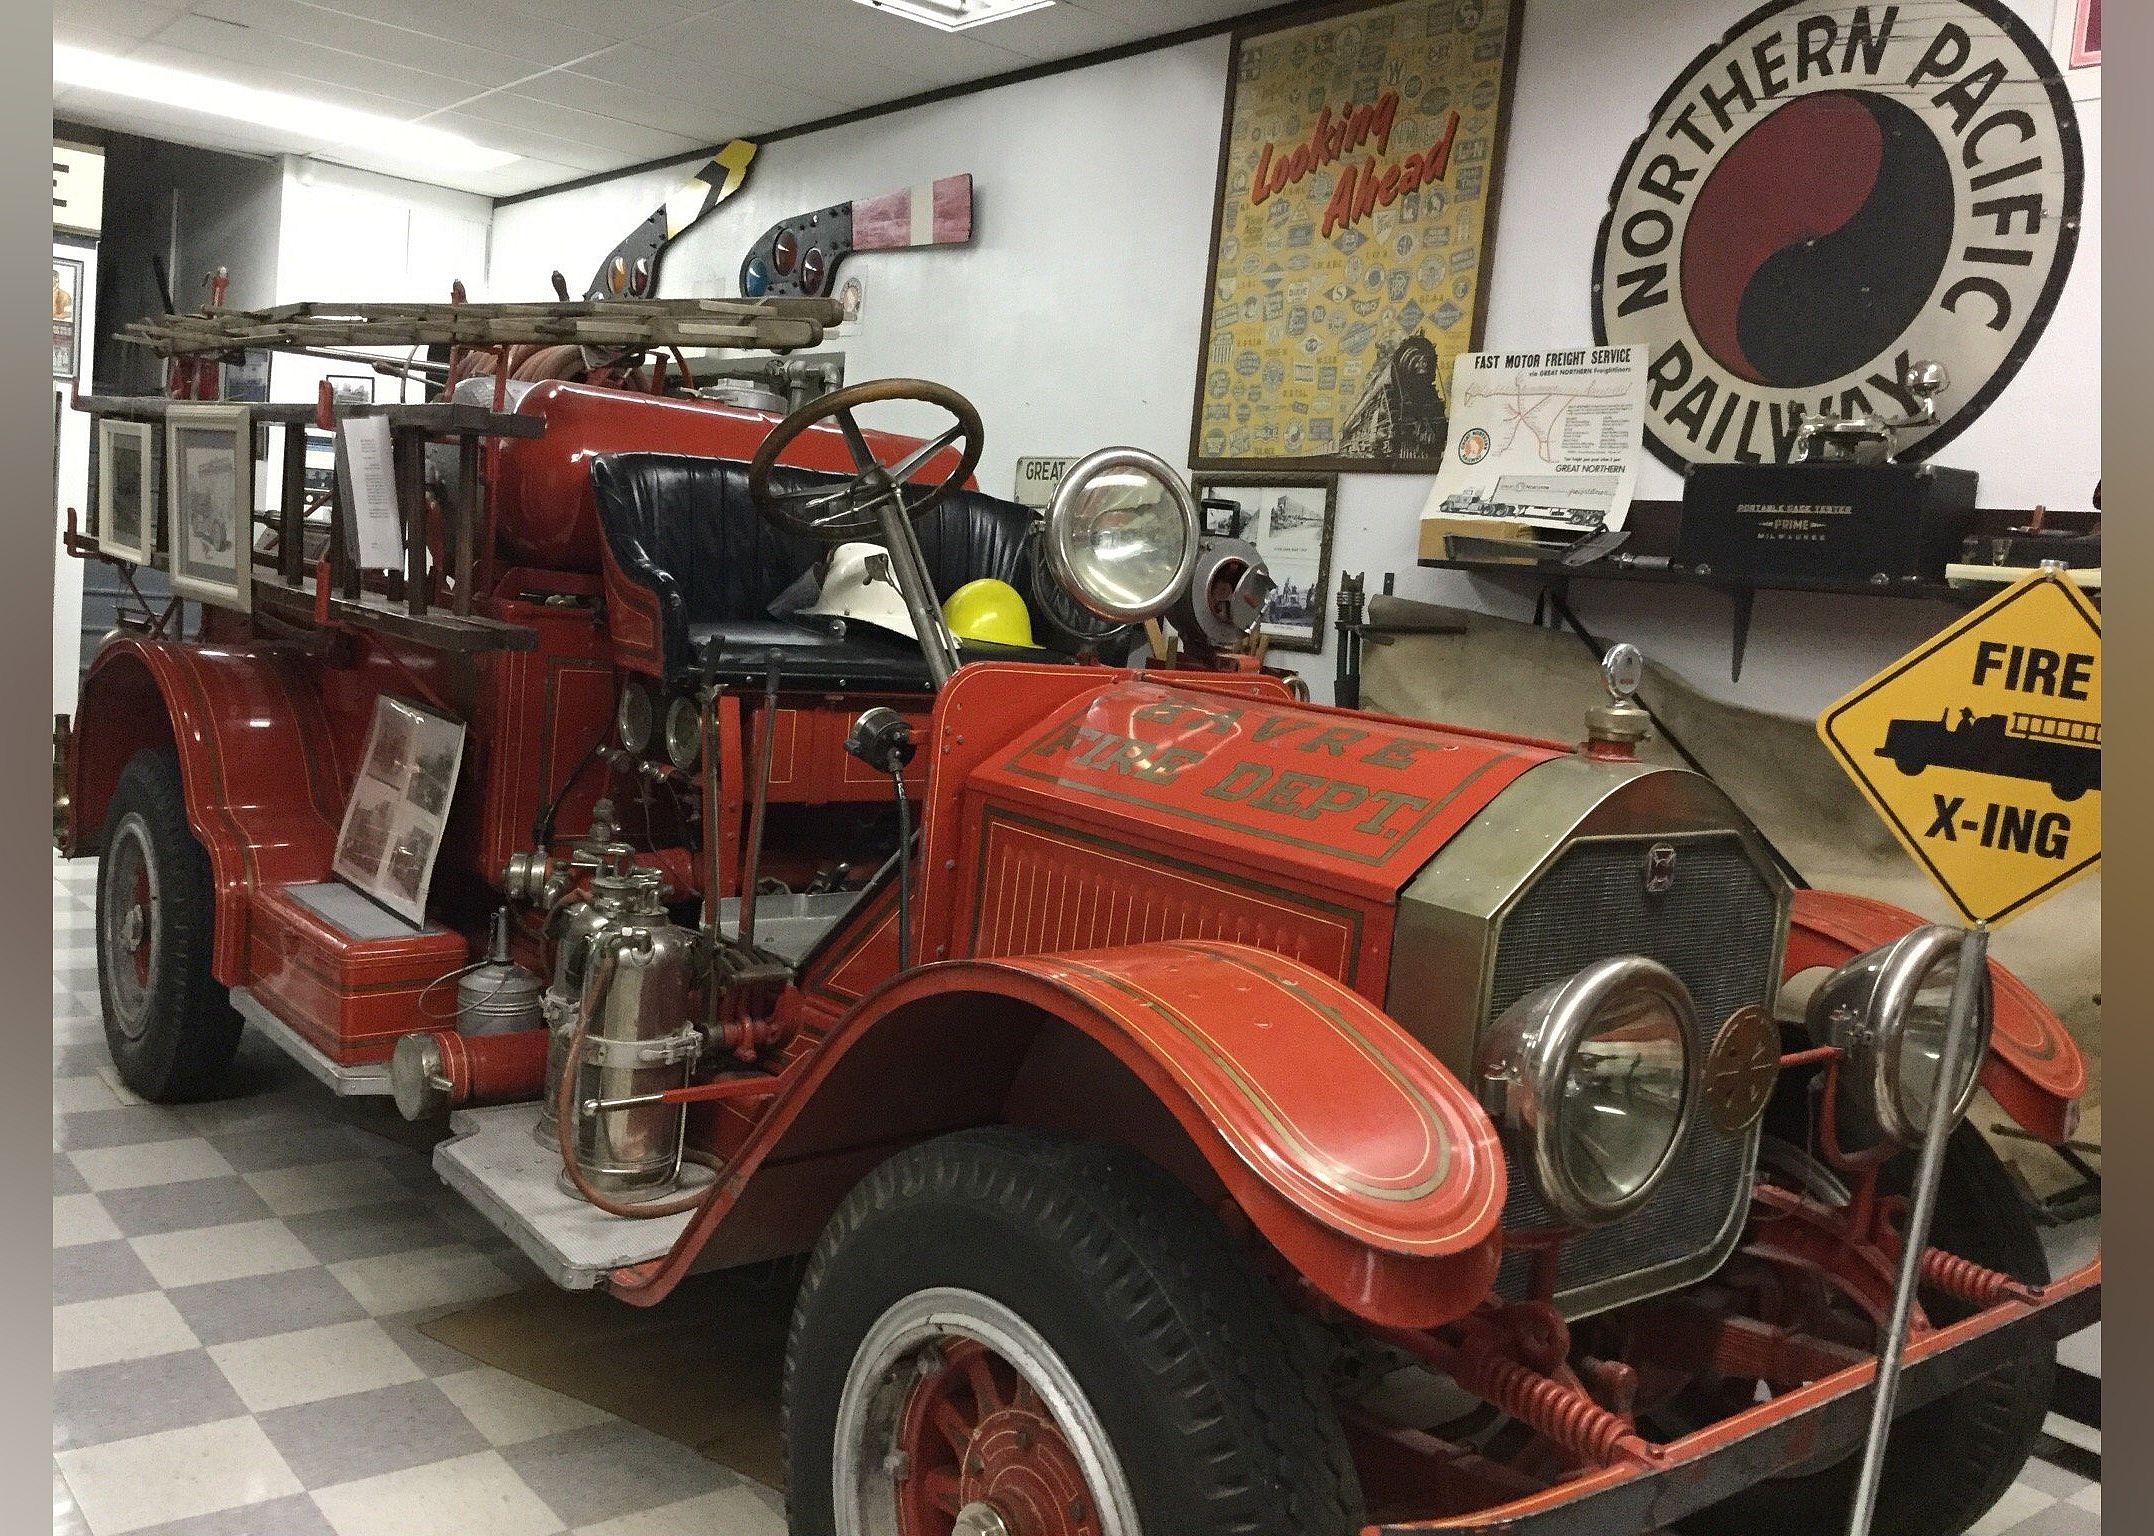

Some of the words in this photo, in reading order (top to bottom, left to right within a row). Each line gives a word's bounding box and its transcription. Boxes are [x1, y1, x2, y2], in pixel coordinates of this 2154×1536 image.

[1251, 88, 1400, 205] Looking
[1322, 110, 1461, 238] Ahead
[1616, 6, 1900, 319] NORTHERN
[1907, 21, 2044, 333] PACIFIC
[1475, 355, 1500, 369] FAST
[1505, 354, 1540, 369] MOTOR
[1545, 351, 1586, 367] FREIGHT
[1591, 348, 1632, 365] SERVICE
[1540, 369, 1559, 377] GREAT
[1559, 368, 1592, 376] NORTHERN
[1026, 461, 1066, 480] GREAT
[1555, 464, 1580, 473] GREAT
[1582, 464, 1626, 474] NORTHERN
[1774, 519, 1809, 530] PRIME
[1972, 640, 2095, 701] FIRE
[1132, 697, 1446, 769] HAVRE
[1032, 725, 1206, 785] FIRE
[1203, 761, 1434, 838] DEPT.
[1924, 793, 2072, 860] X-ING
